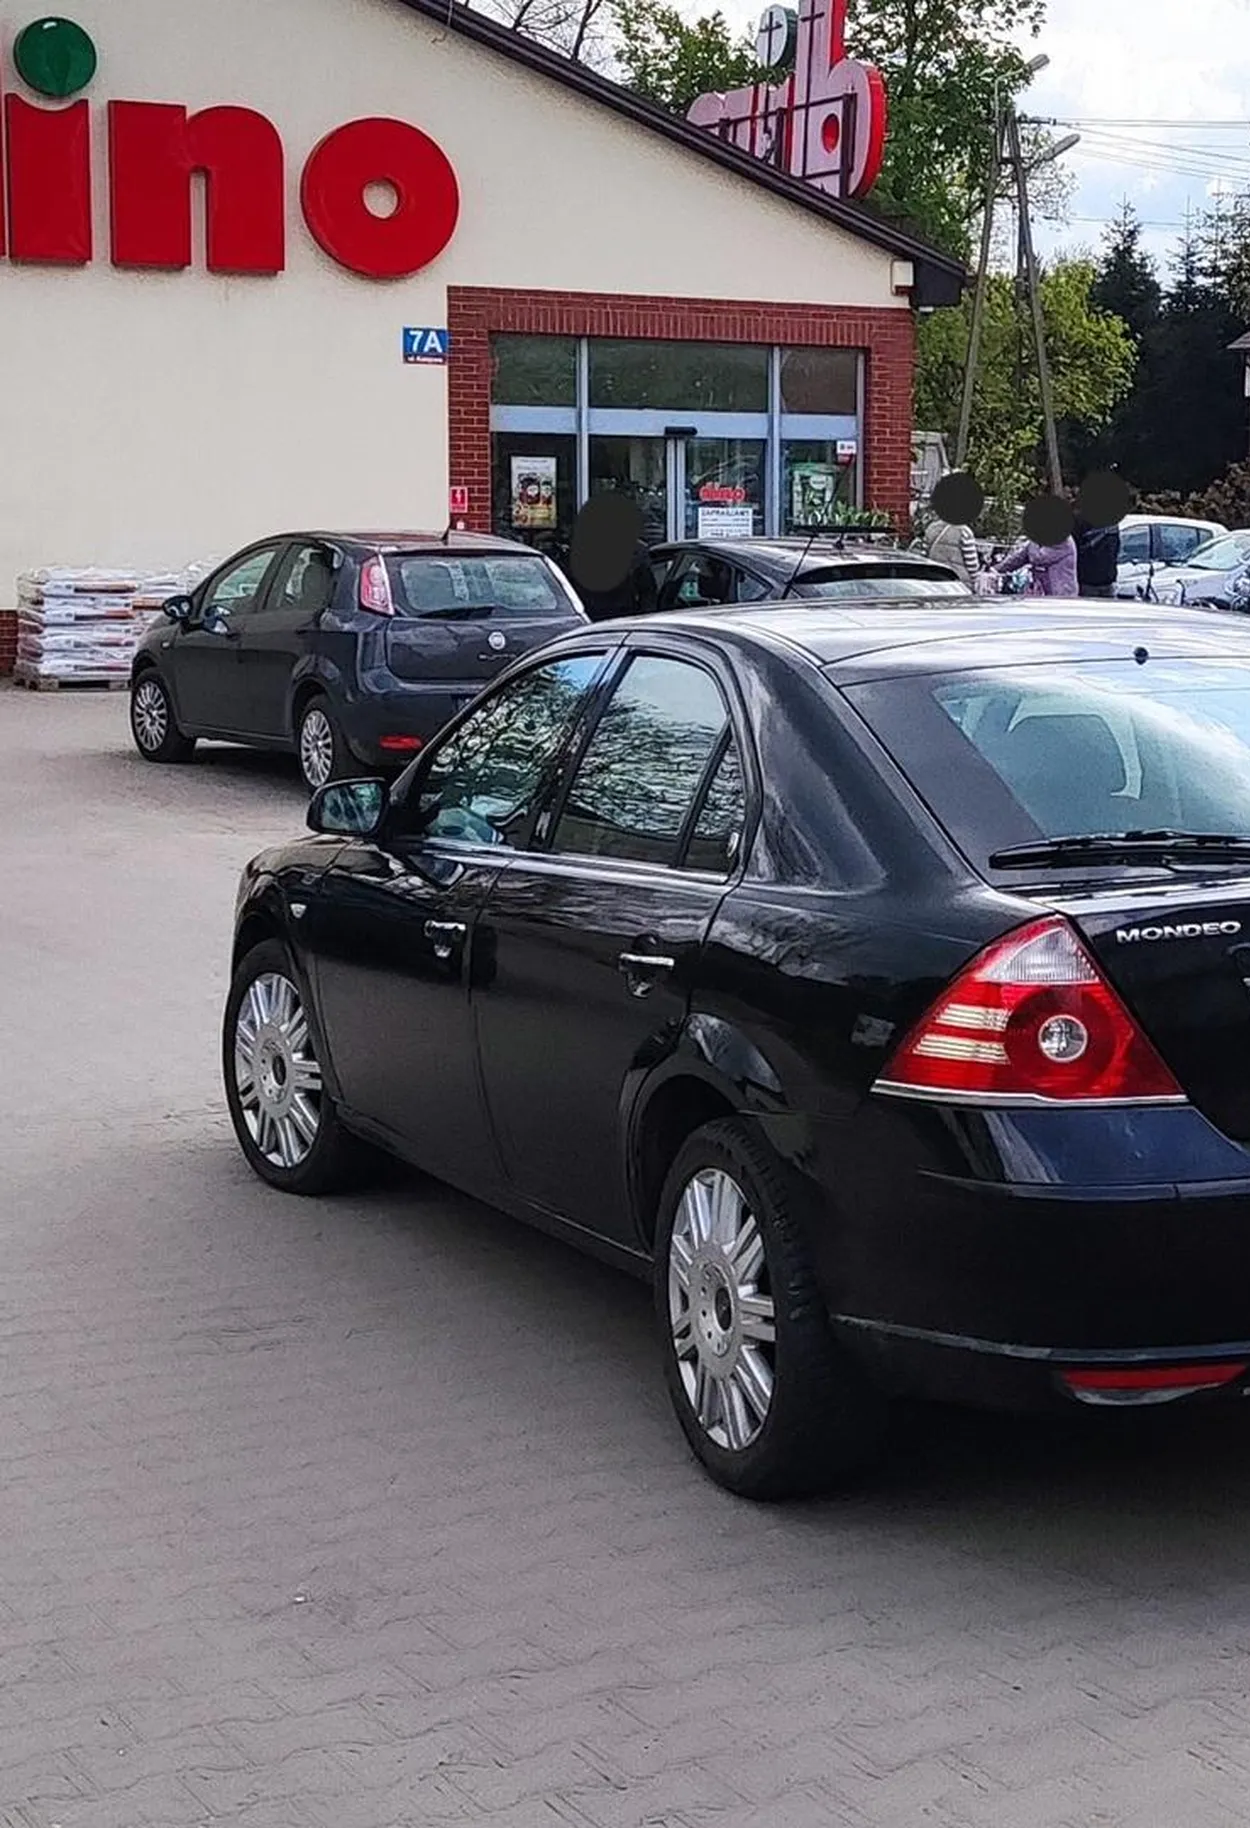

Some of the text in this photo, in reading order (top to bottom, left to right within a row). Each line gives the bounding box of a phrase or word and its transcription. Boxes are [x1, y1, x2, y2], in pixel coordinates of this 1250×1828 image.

[0, 16, 460, 279] ino
[408, 329, 443, 353] 7A
[1115, 920, 1242, 944] MONDEO
